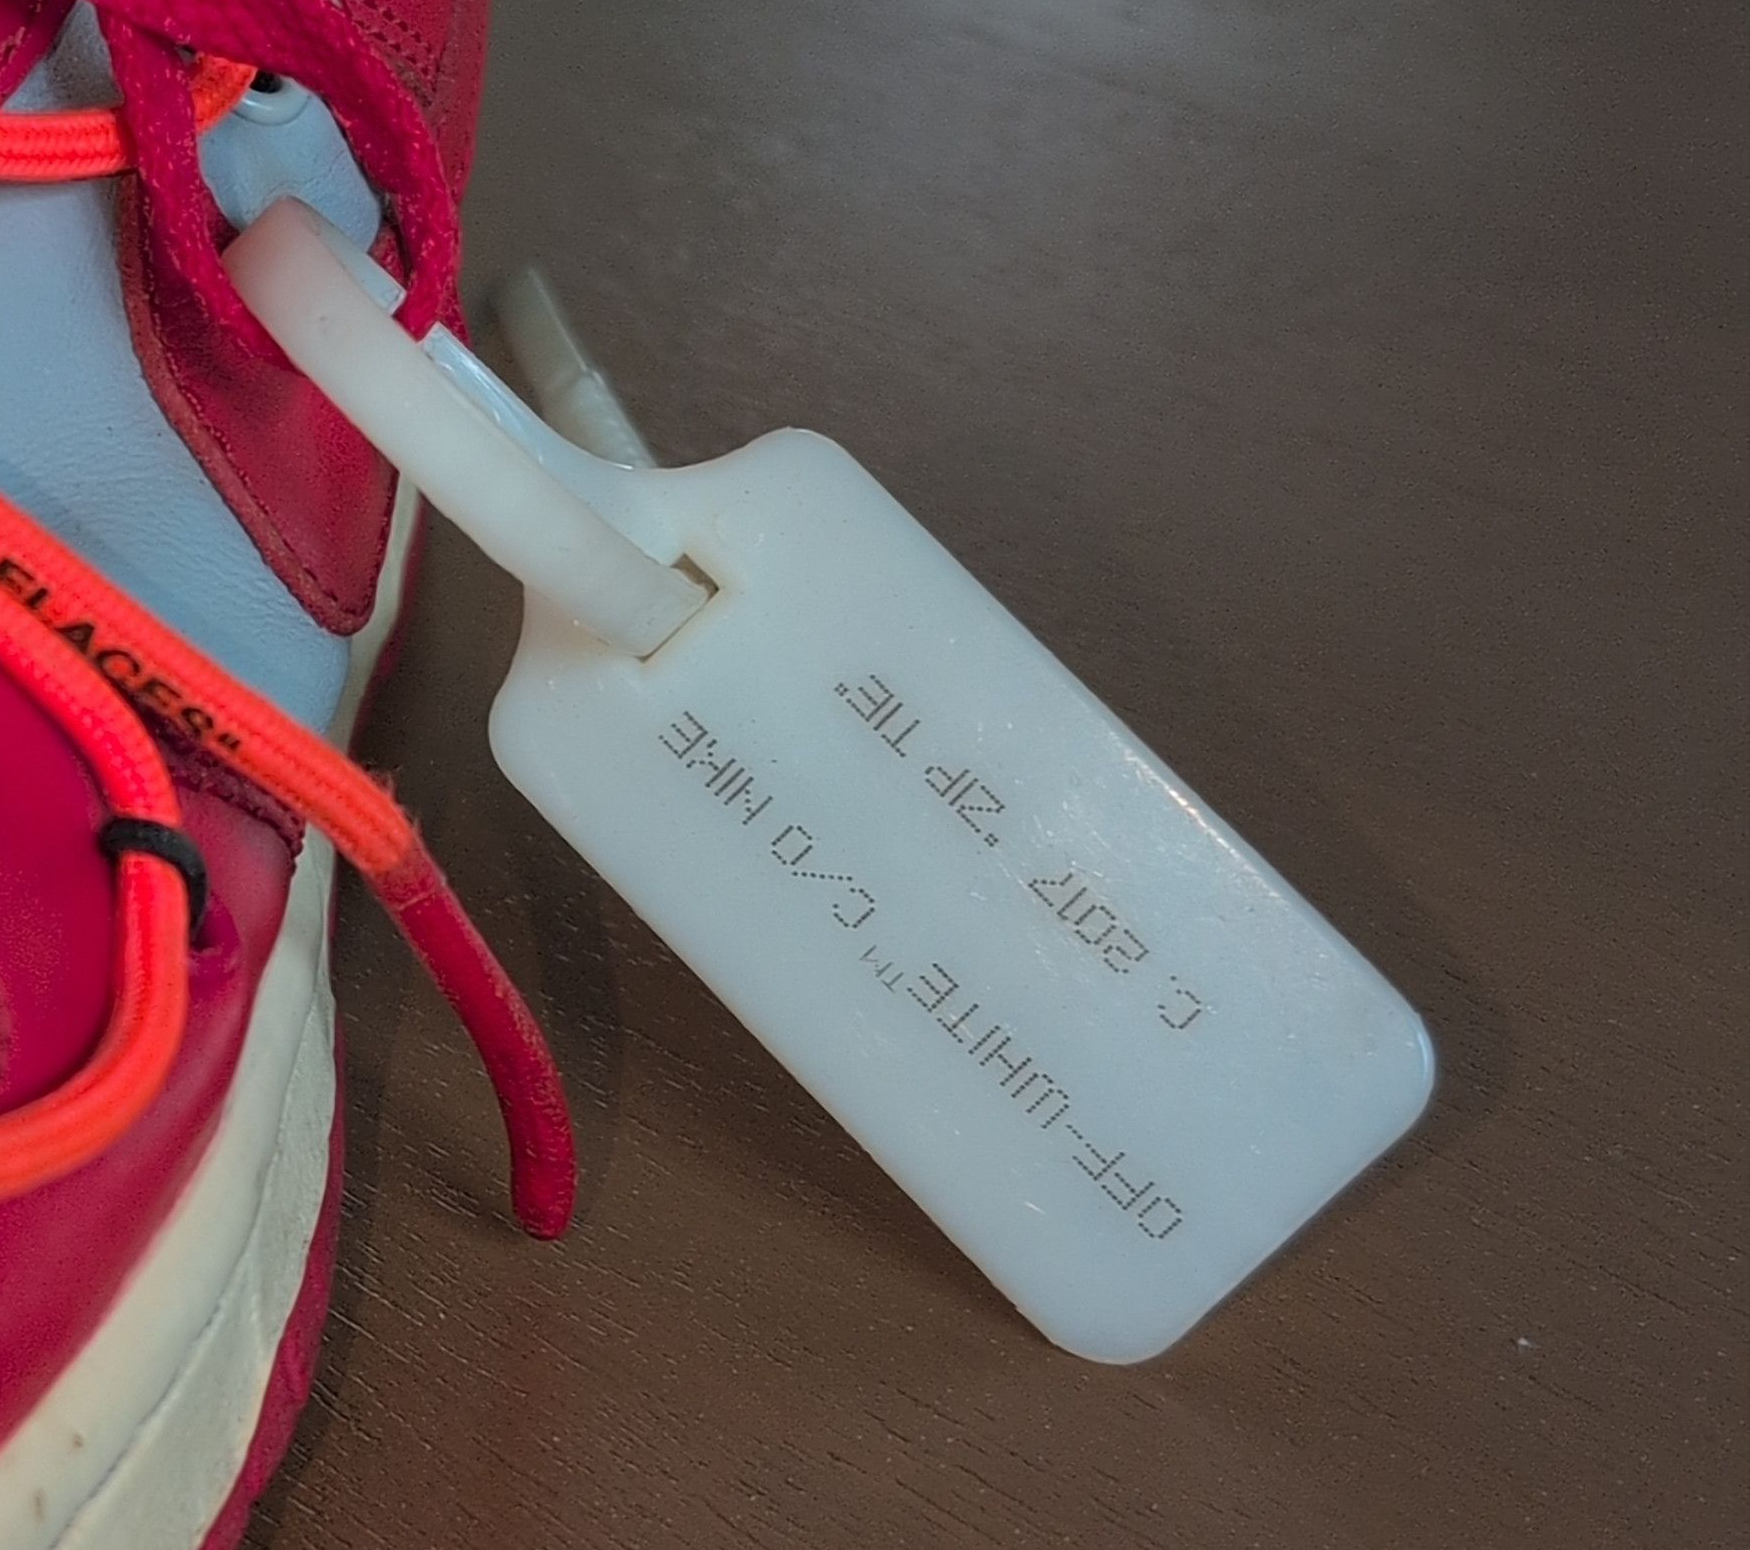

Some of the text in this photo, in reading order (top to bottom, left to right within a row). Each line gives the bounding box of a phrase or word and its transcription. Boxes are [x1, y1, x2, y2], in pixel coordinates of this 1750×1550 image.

[658, 711, 772, 826] NIKE
[771, 824, 876, 928] C/O
[833, 674, 1203, 1031] C. 2017 "ZIP TIE"
